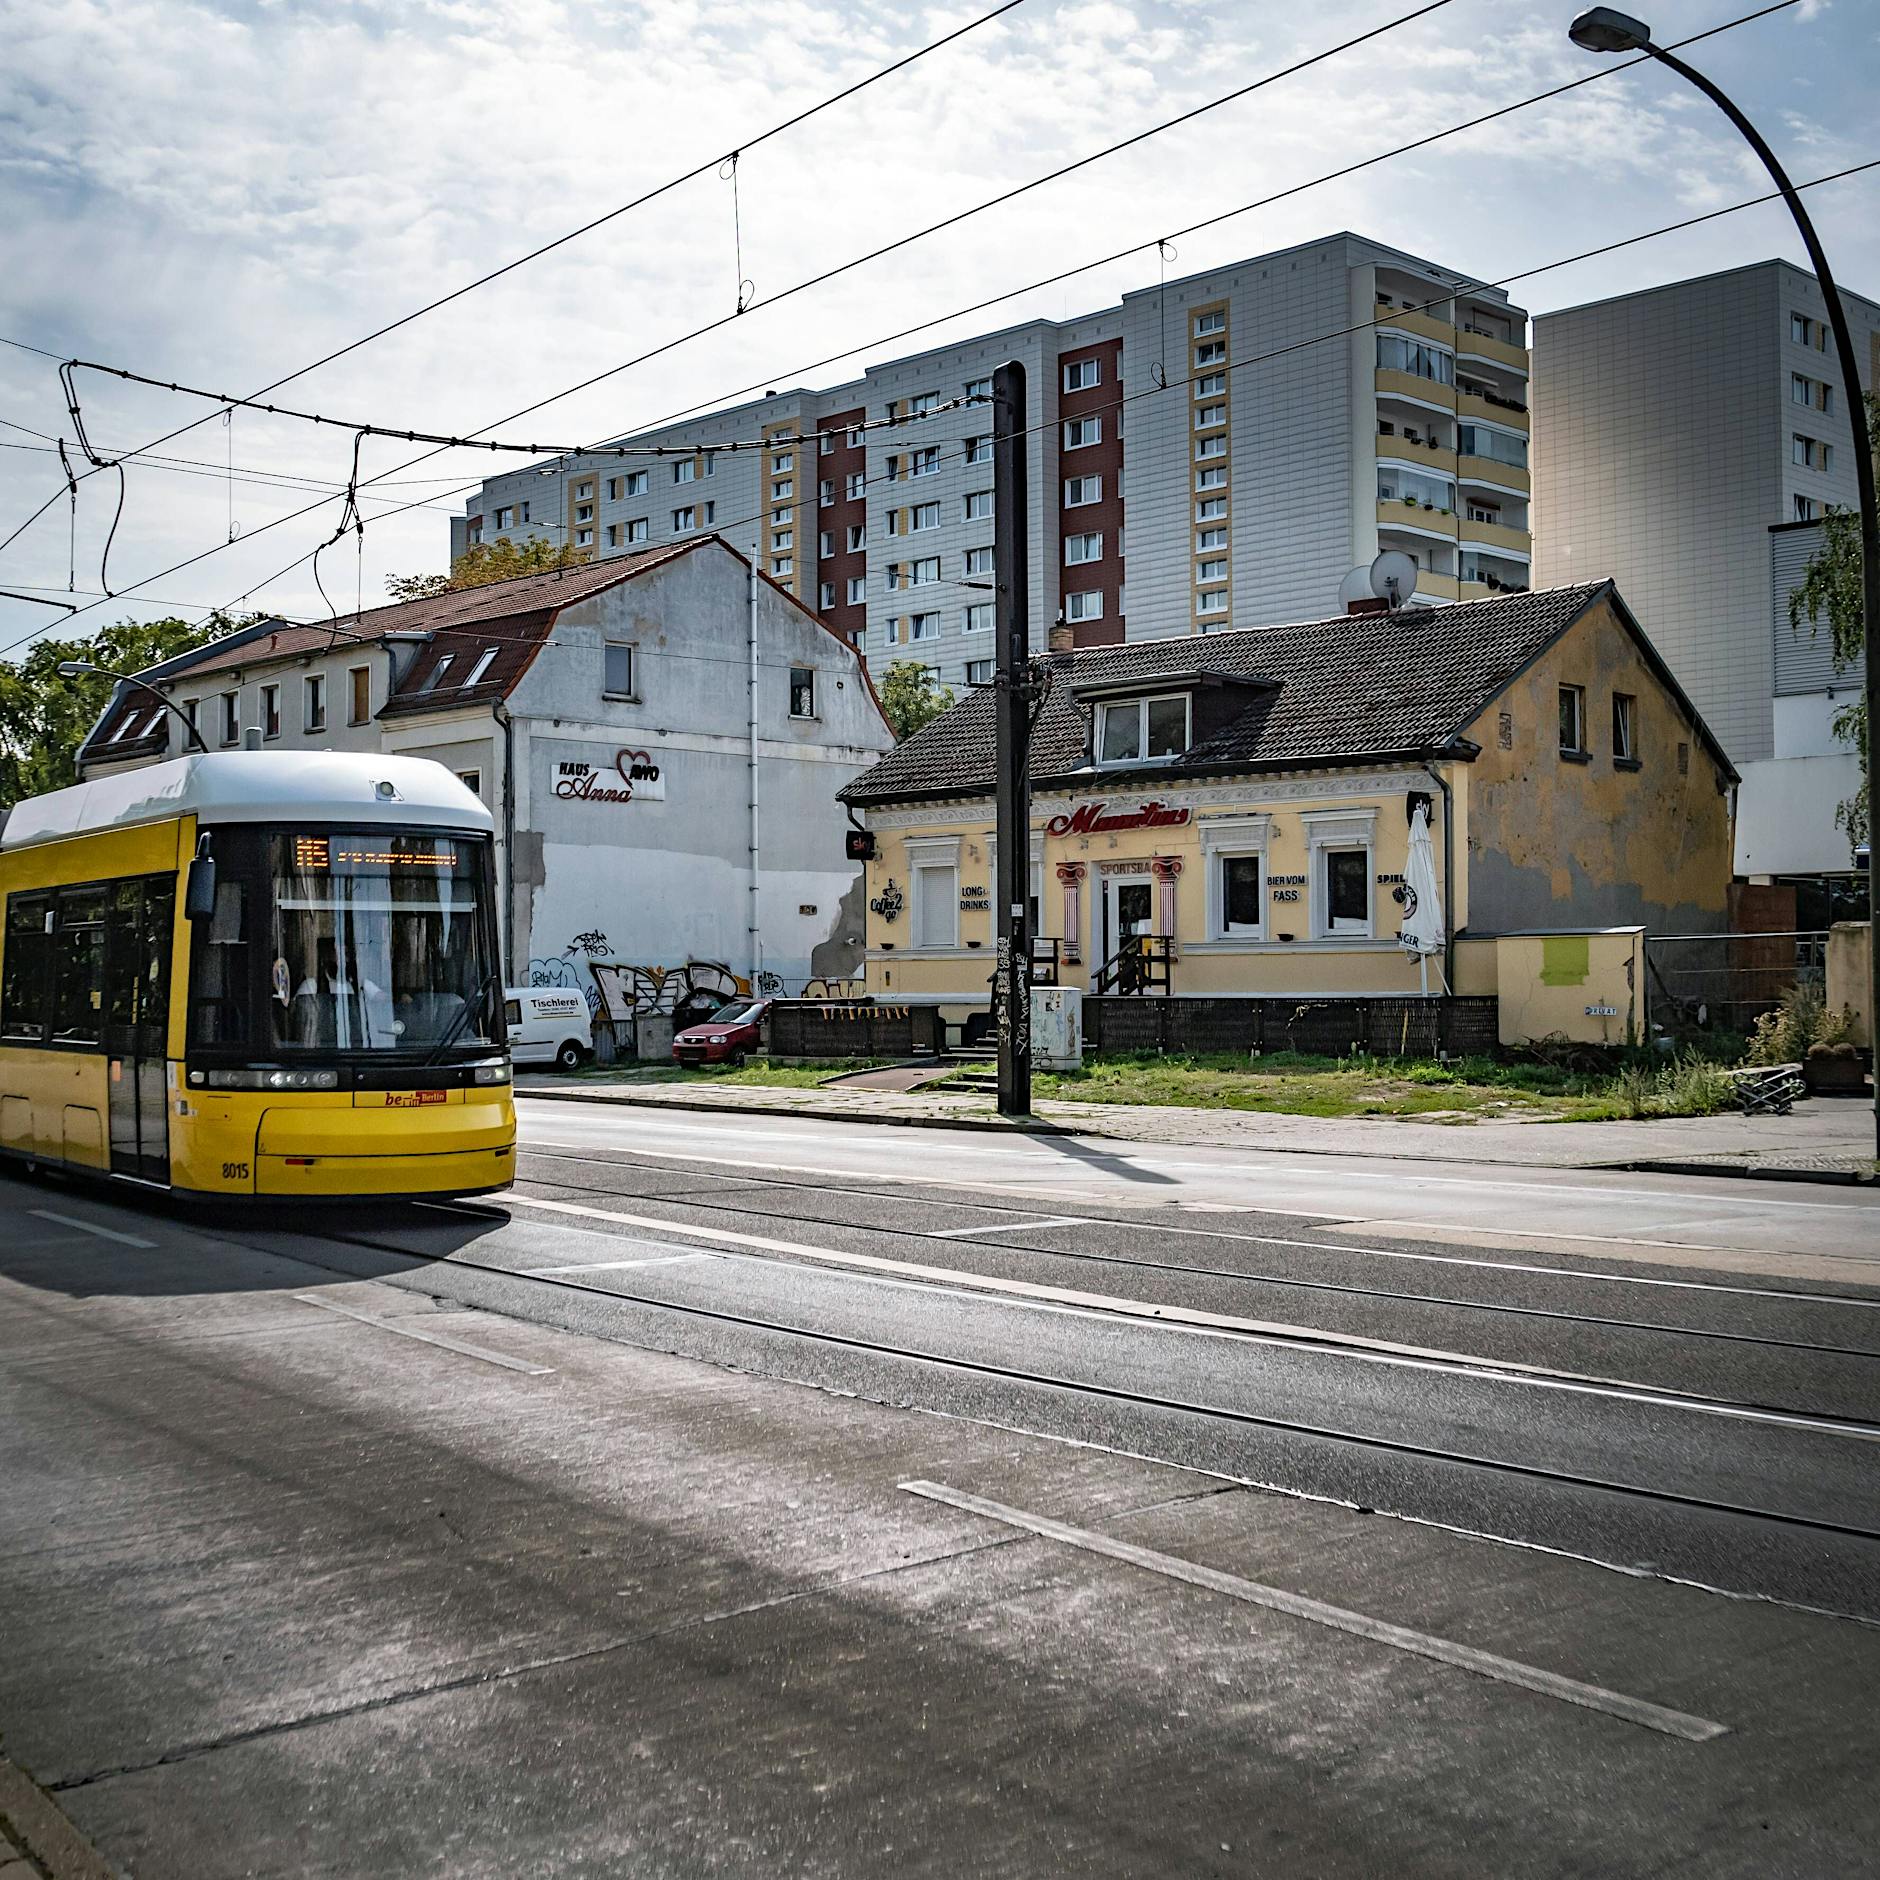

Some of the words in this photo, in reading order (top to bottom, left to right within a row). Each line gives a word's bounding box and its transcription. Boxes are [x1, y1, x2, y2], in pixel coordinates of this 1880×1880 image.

[559, 762, 590, 776] HAUS
[629, 764, 660, 782] AWO
[556, 771, 632, 803] Anna
[1100, 862, 1152, 875] SPORTSBA
[1267, 876, 1285, 886] BIER
[1286, 875, 1305, 885] VOM
[1273, 890, 1298, 901] FASS
[871, 898, 895, 915] Coffee
[894, 893, 903, 910] 2
[960, 899, 989, 910] DRINKS
[885, 910, 897, 923] go
[530, 998, 579, 1008] Tischlerei
[385, 1092, 402, 1106] be
[421, 1093, 445, 1102] Berlin
[222, 1163, 249, 1179] 8015
